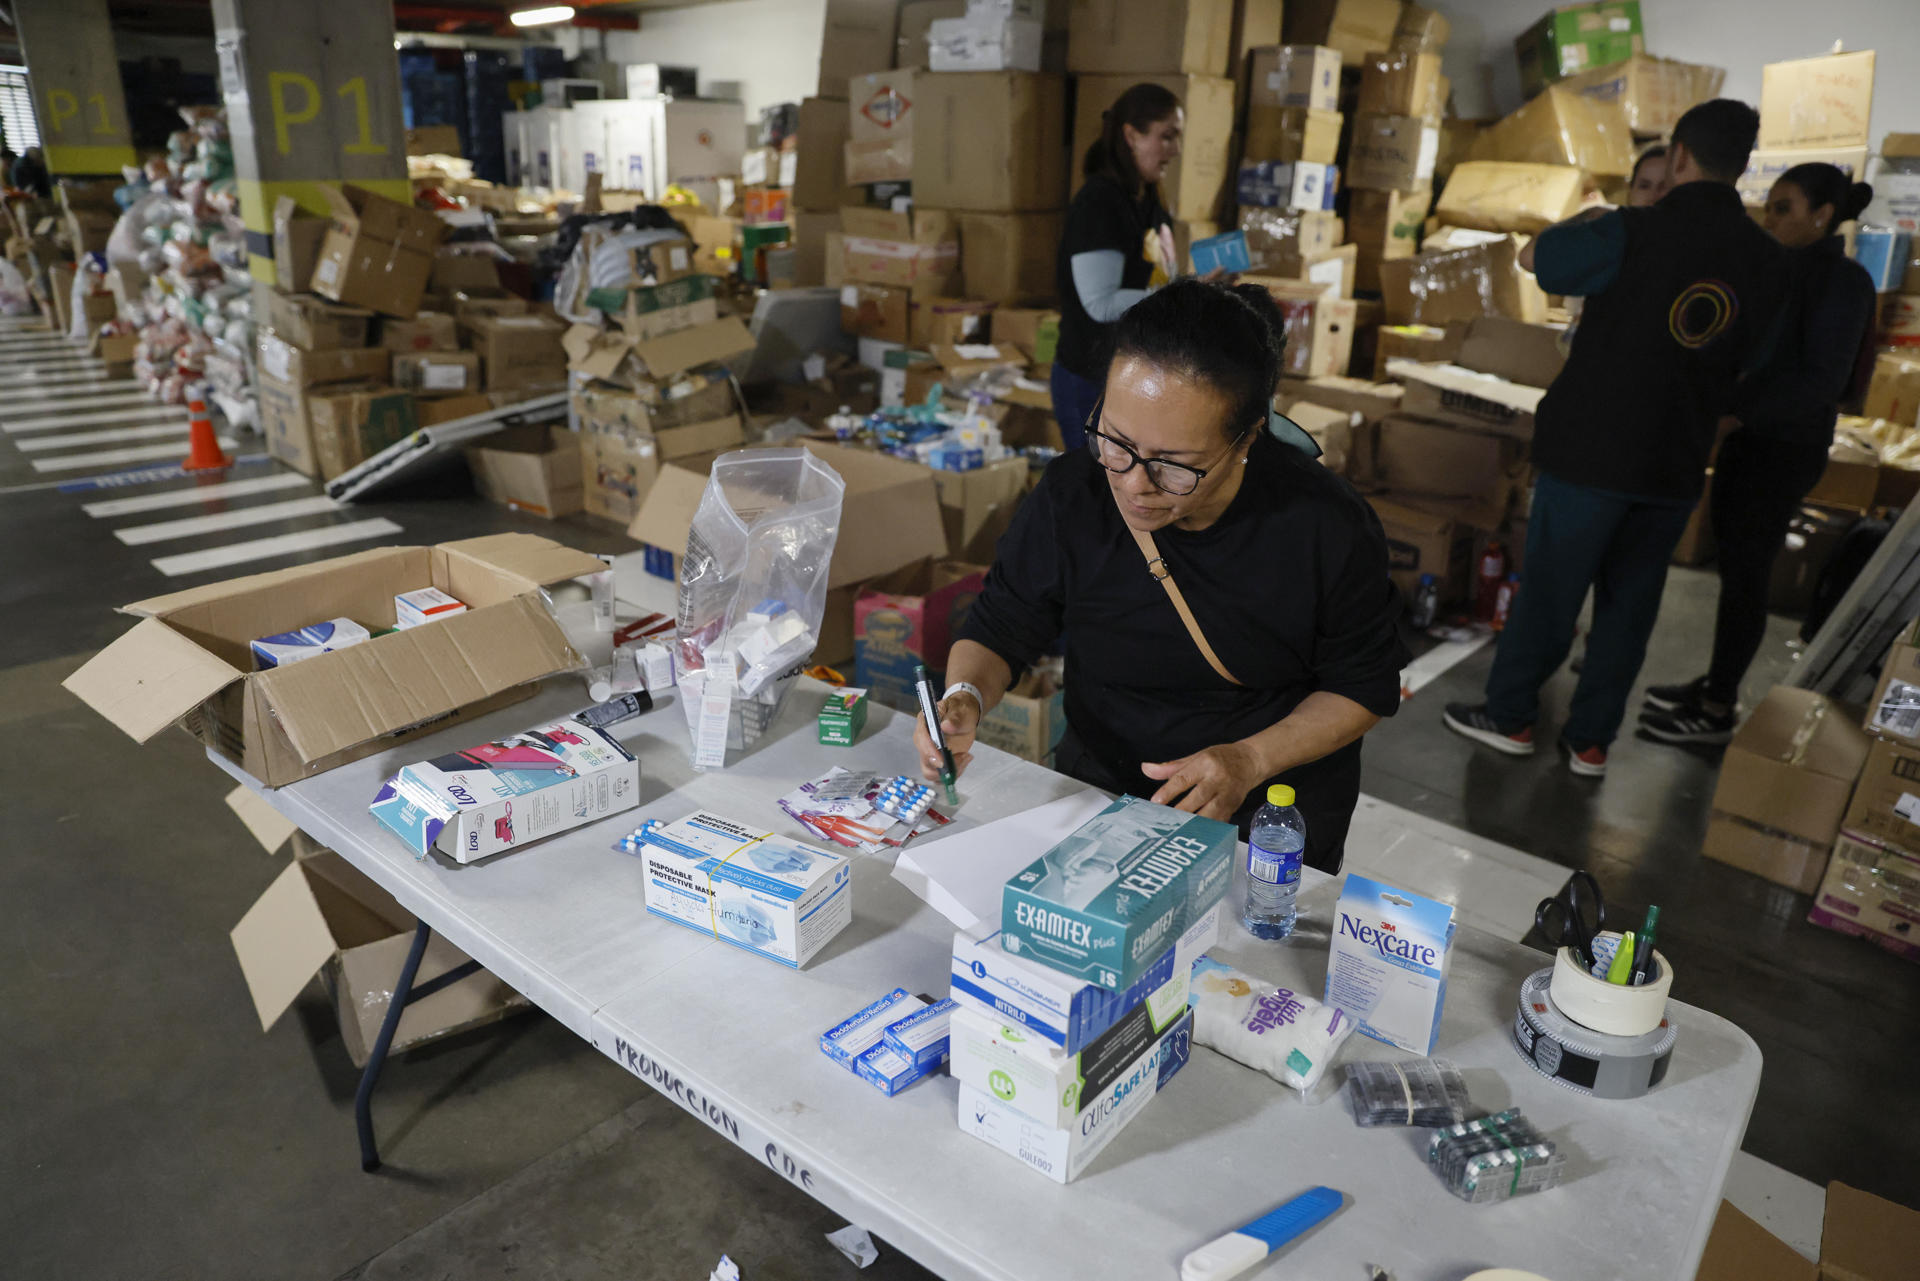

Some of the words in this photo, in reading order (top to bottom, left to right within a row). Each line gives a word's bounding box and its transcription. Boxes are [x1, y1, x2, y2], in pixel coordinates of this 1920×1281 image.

[47, 88, 117, 135] P1
[268, 70, 388, 156] P1
[447, 785, 478, 805] LORD
[691, 816, 742, 834] PROTECTIVE
[698, 813, 746, 832] DISPOSABLE
[468, 831, 479, 851] LORD
[649, 859, 693, 882] DISPOSABLE
[1119, 836, 1209, 899] EXAMTEX
[649, 868, 694, 890] PROTECTIVE
[694, 883, 717, 898] MASK
[1014, 901, 1092, 948] EXAMTEX
[1131, 907, 1176, 960] EXAMTEX
[1338, 912, 1436, 966] Nexcare
[1380, 921, 1397, 933] 3M
[830, 1013, 869, 1039] Diclofenaco
[867, 1000, 892, 1018] Retard
[893, 1009, 935, 1032] Diclofenaco
[994, 997, 1027, 1023] NITRILO
[1246, 987, 1295, 1036] angels
[1273, 999, 1306, 1027] little
[615, 1036, 740, 1142] PRODUCCION
